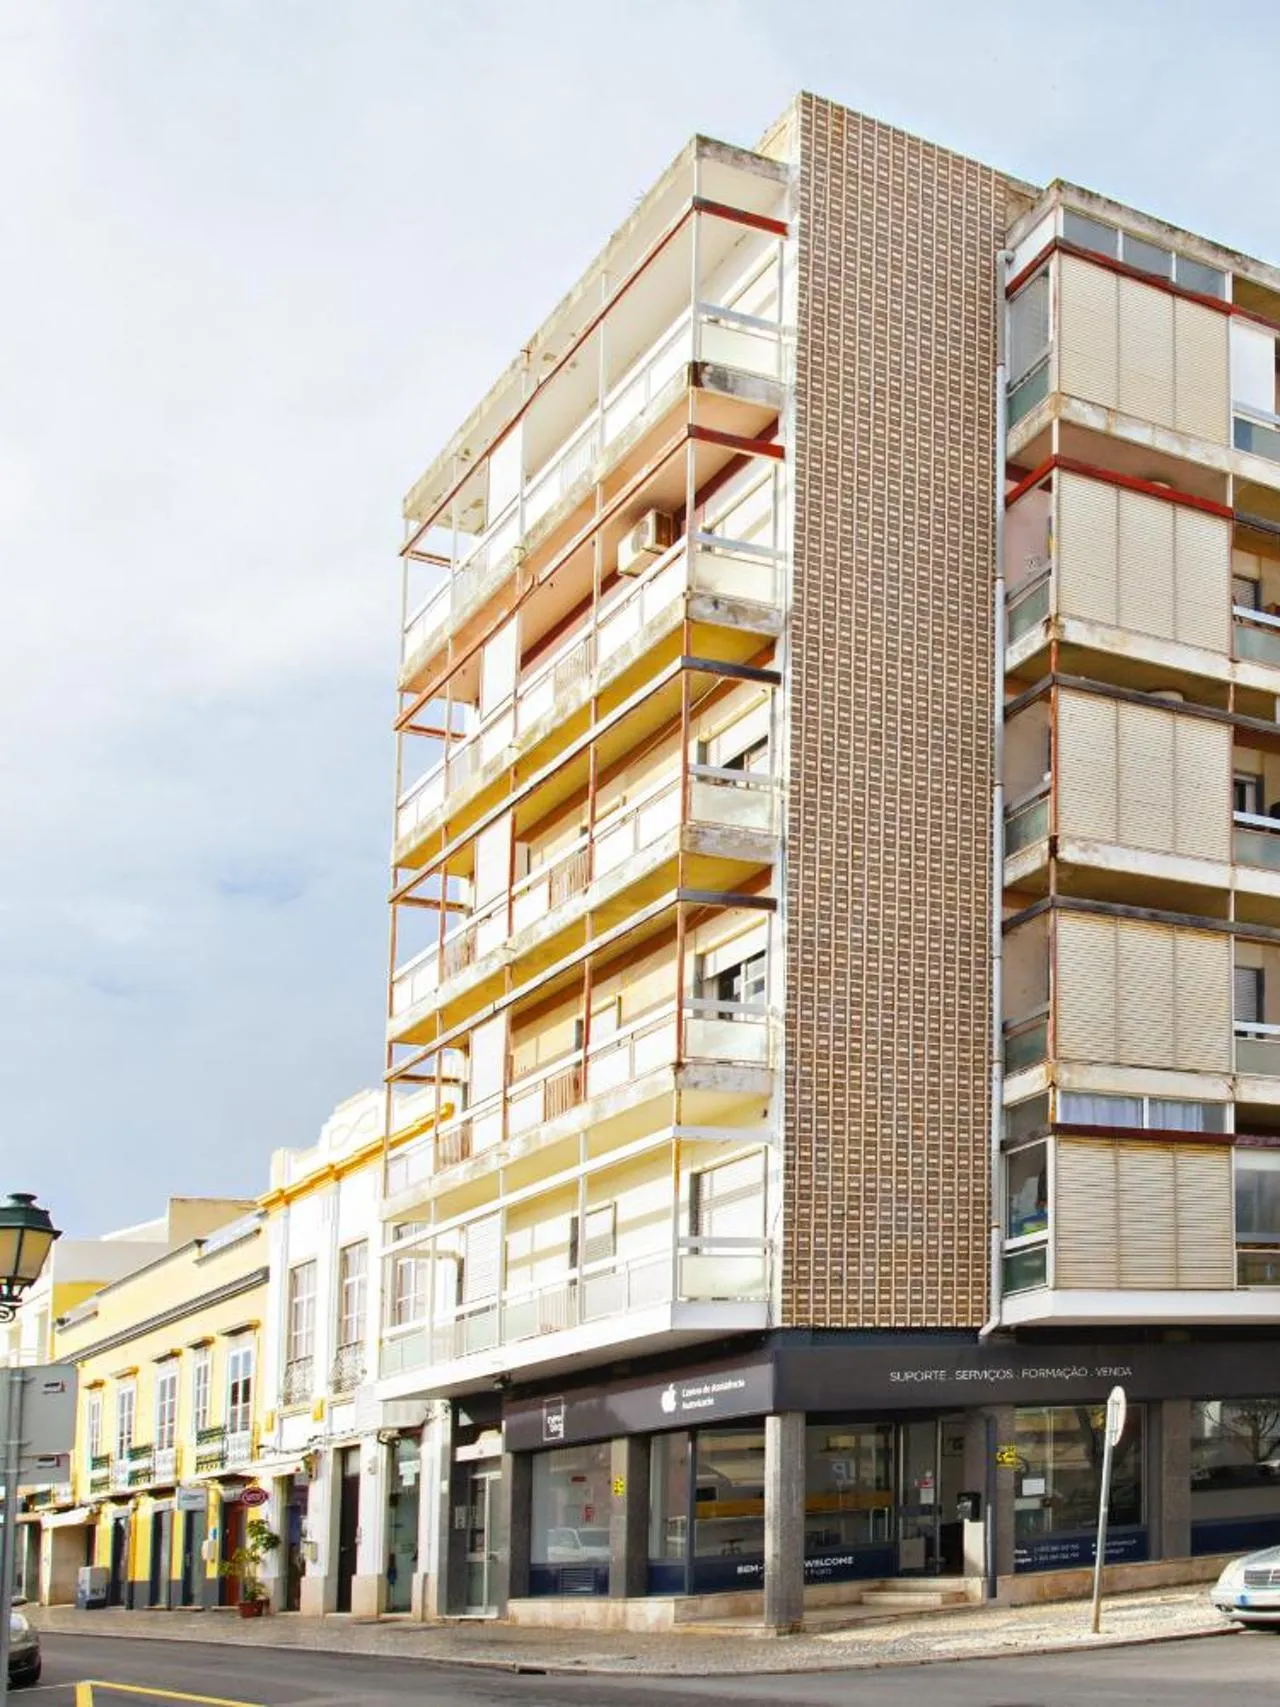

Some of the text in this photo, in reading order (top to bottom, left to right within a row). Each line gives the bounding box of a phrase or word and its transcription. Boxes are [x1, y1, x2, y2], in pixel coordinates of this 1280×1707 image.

[889, 1365, 1132, 1382] SUPORTE SERVIÇOS FORMAÇÃO VENDA
[804, 1556, 854, 1568] WELCOME
